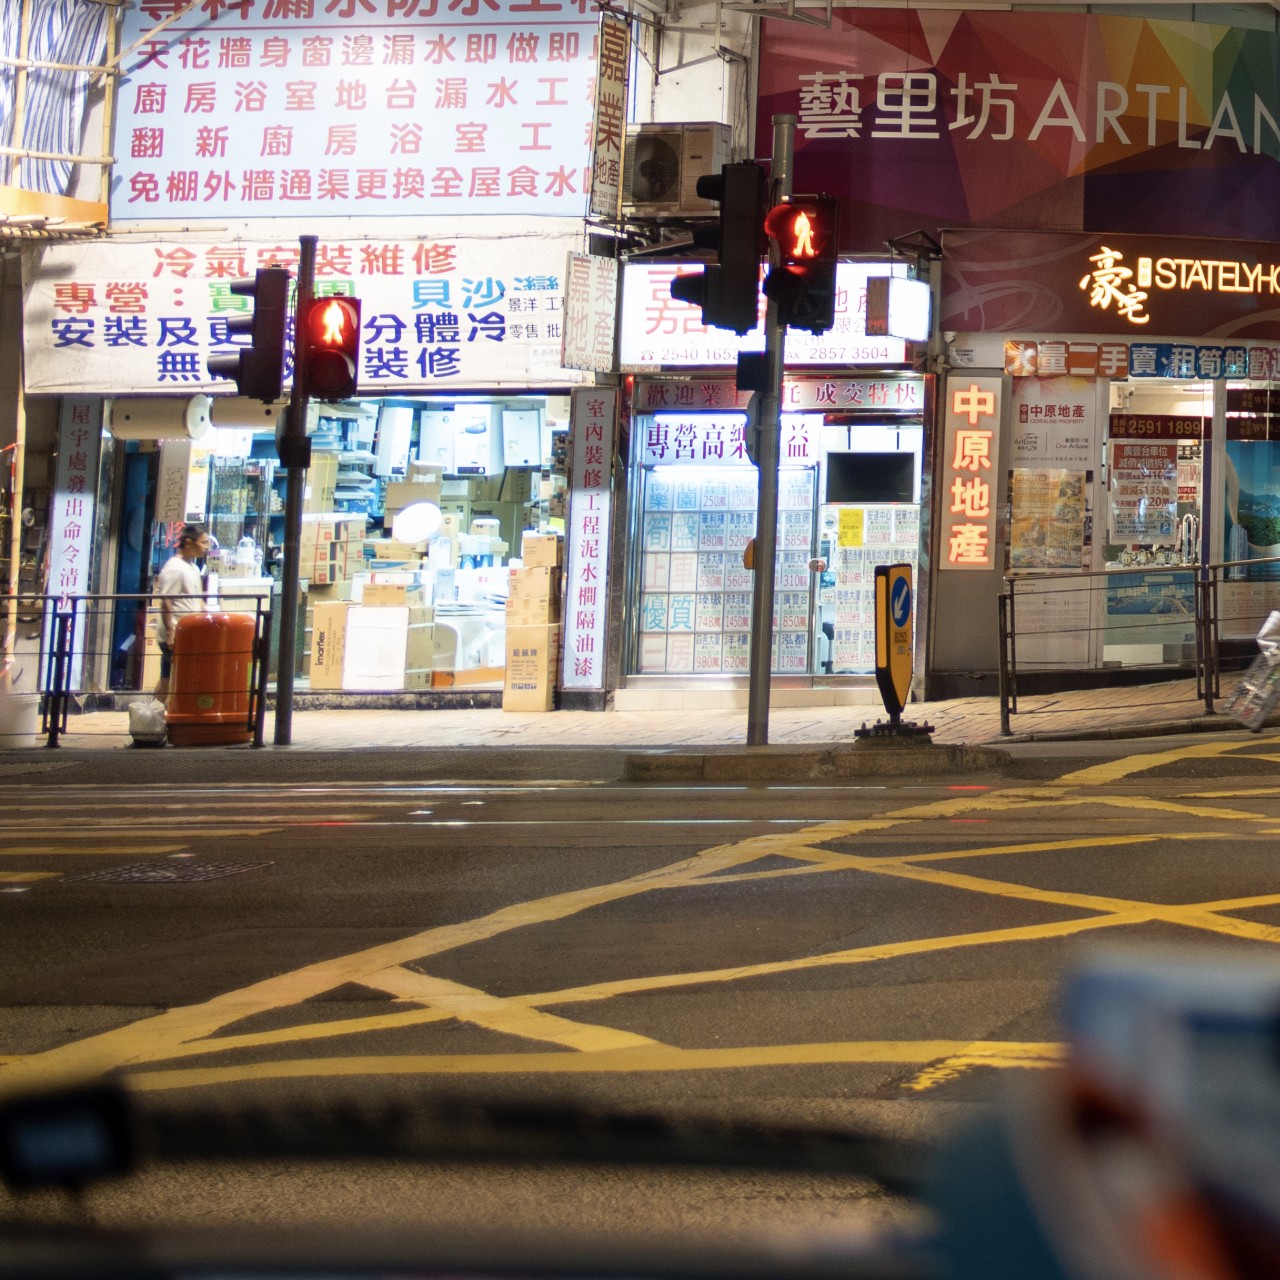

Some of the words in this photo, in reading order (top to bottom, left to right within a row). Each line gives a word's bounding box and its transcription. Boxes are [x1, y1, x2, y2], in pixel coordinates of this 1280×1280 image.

[597, 22, 627, 152] 嘉業
[797, 70, 1018, 140] 藝里坊
[153, 243, 457, 278] 冷氣安裝維修
[571, 256, 614, 305] 嘉業
[508, 297, 538, 313] 景洋
[566, 306, 613, 355] 地產
[661, 349, 698, 361] 2540
[705, 349, 738, 361] 1652
[810, 348, 848, 361] 2857
[852, 347, 889, 360] 3504
[647, 382, 800, 406] 歡迎業主托
[815, 383, 917, 405] 成交特快
[1030, 404, 1085, 418] 中原地產
[647, 422, 810, 460] 專營高樂益
[1128, 420, 1162, 434] 2591
[1167, 421, 1201, 435] 1899
[949, 384, 995, 563] 中原地產
[784, 535, 809, 547] 585萬
[643, 594, 694, 630] 優質
[783, 615, 808, 628] 850萬
[781, 633, 806, 645] 泓都
